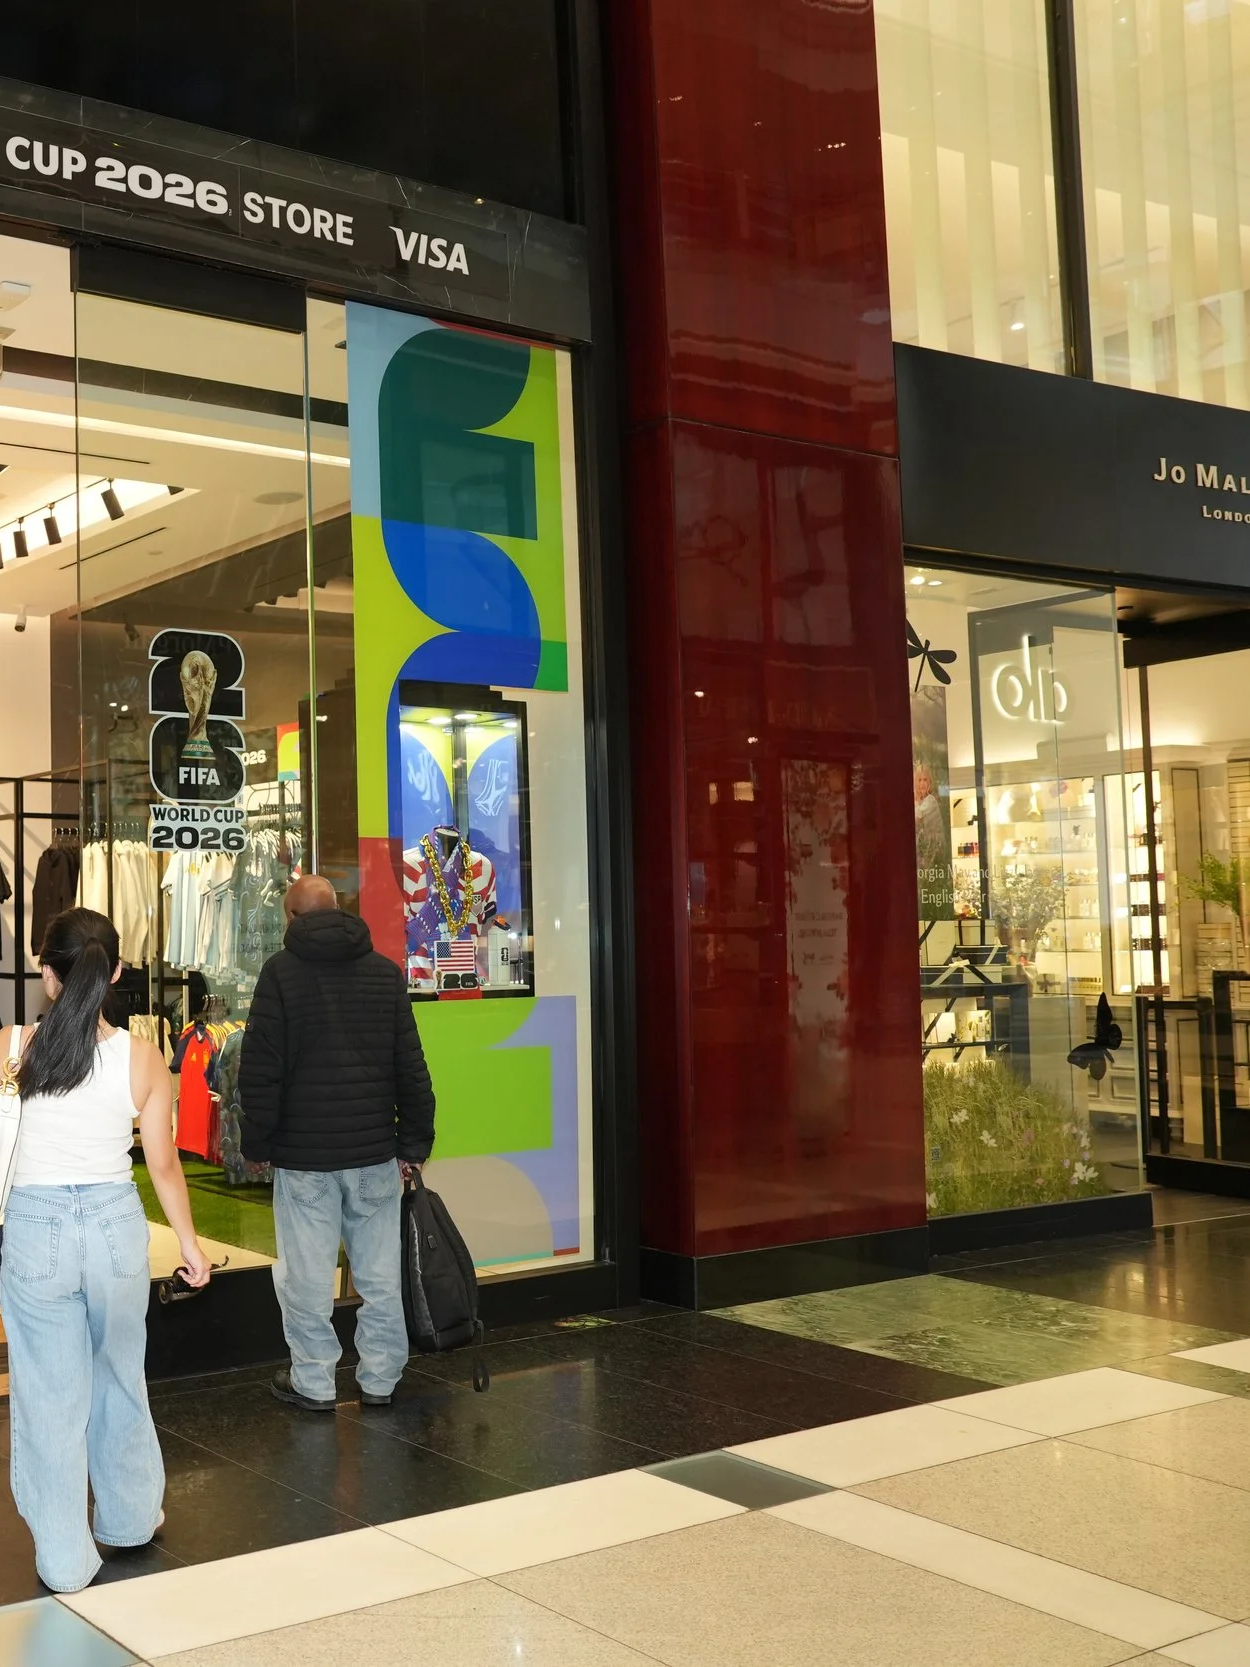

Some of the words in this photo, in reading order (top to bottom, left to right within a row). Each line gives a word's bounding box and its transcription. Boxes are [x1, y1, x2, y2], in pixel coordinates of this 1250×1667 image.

[5, 136, 87, 181] CUP
[94, 156, 230, 216] 2026
[242, 191, 355, 247] STORE
[388, 225, 470, 276] VISA
[178, 766, 221, 786] FIFA
[152, 806, 211, 823] WORLD
[213, 808, 245, 824] CUP
[152, 825, 245, 851] 2026
